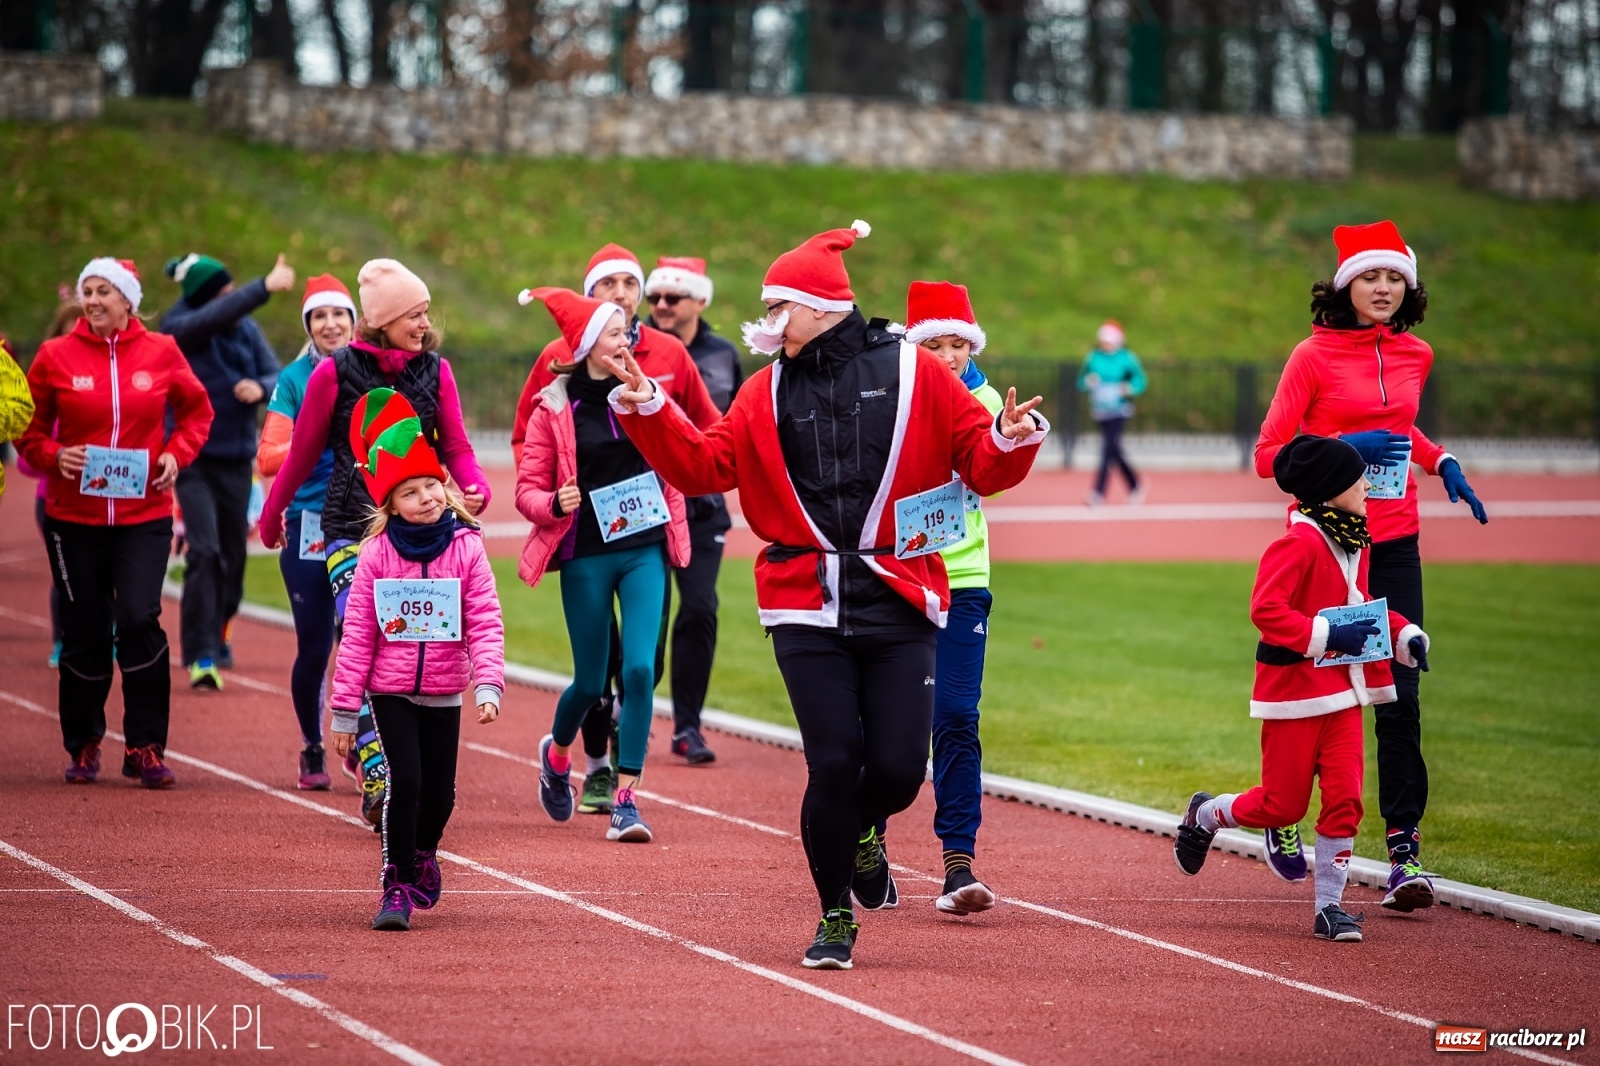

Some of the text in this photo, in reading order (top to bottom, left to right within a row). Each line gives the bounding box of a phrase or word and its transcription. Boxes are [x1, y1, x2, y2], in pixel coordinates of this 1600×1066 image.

[104, 464, 129, 478] 048
[619, 496, 643, 514] 031
[924, 509, 944, 529] 119
[401, 600, 433, 616] 059
